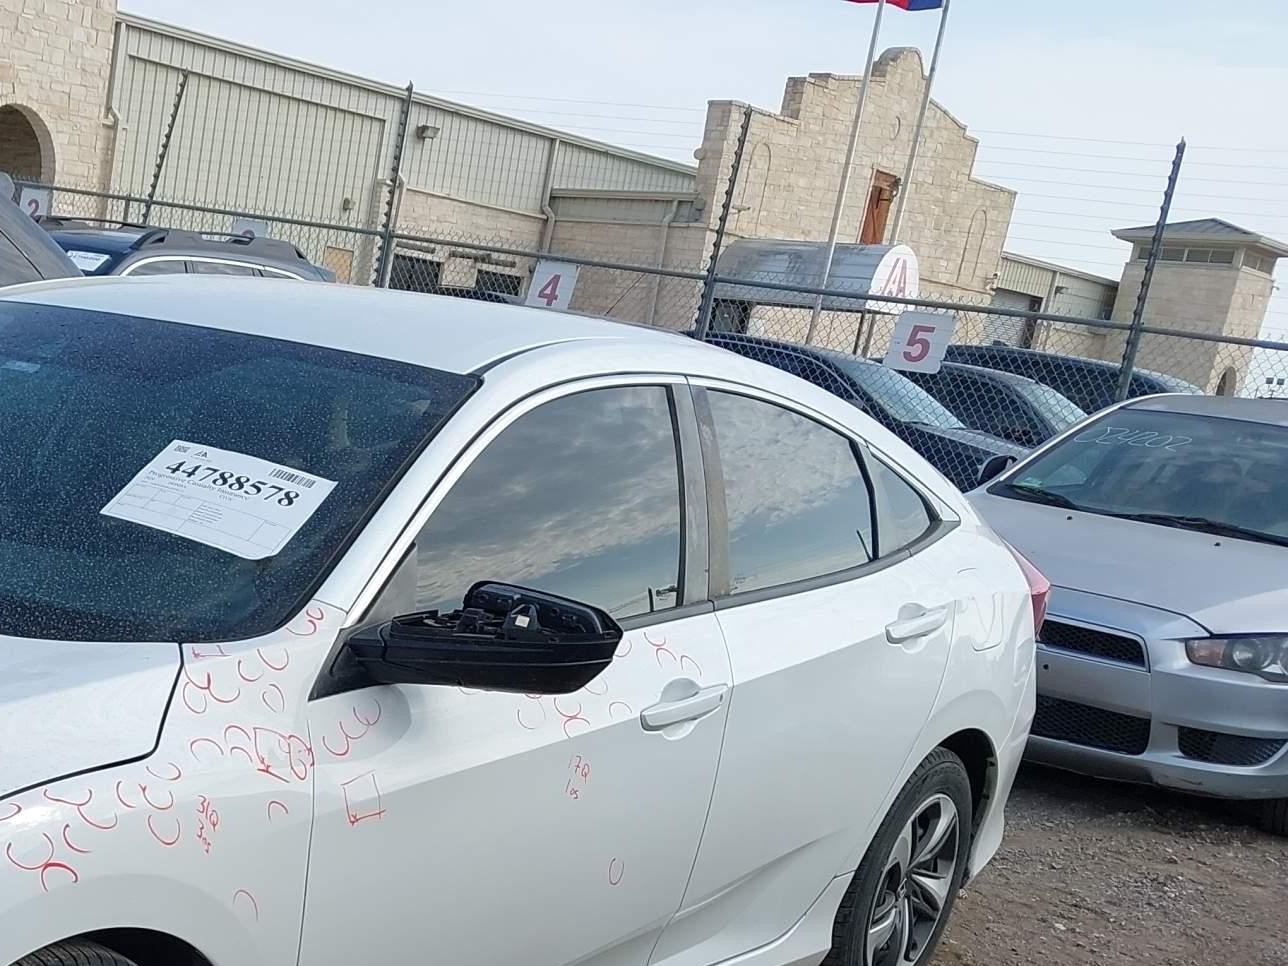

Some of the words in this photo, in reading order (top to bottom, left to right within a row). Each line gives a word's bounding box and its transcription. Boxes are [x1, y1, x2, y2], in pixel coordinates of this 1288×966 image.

[27, 198, 42, 222] 2
[537, 273, 562, 307] 4
[902, 325, 936, 363] 5
[165, 460, 300, 507] 44788578
